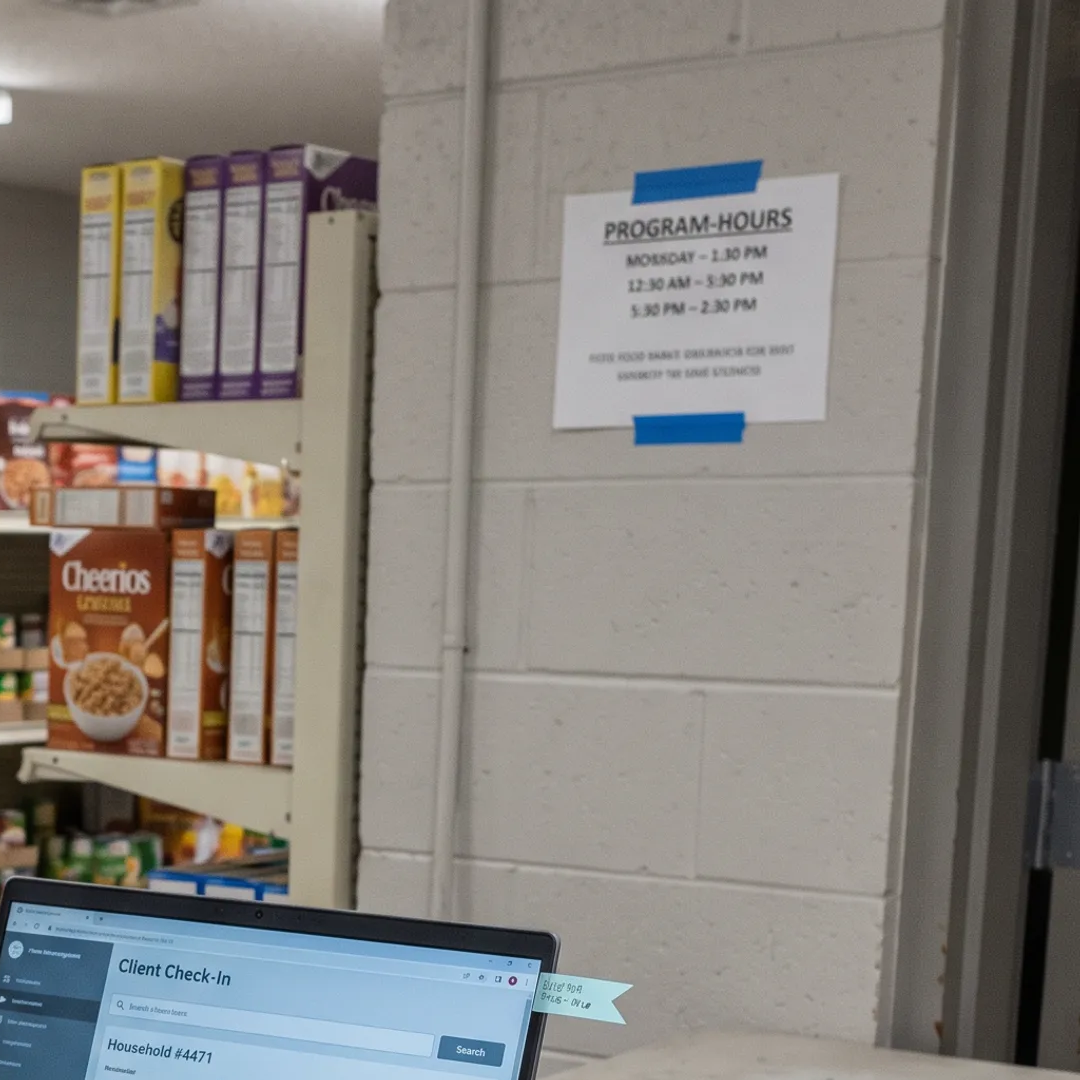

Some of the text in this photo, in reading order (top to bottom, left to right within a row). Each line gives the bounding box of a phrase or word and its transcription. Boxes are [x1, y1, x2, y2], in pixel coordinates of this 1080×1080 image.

[604, 208, 793, 241] PROGRAM-HOURS
[744, 245, 768, 260] PM
[667, 275, 691, 290] AM
[739, 271, 764, 285] PM
[663, 302, 685, 316] PM
[733, 297, 757, 312] PM
[61, 560, 151, 595] Cheerios
[118, 958, 231, 986] Client Check-In
[107, 1038, 212, 1064] Household #4471
[456, 1045, 486, 1057] Search
